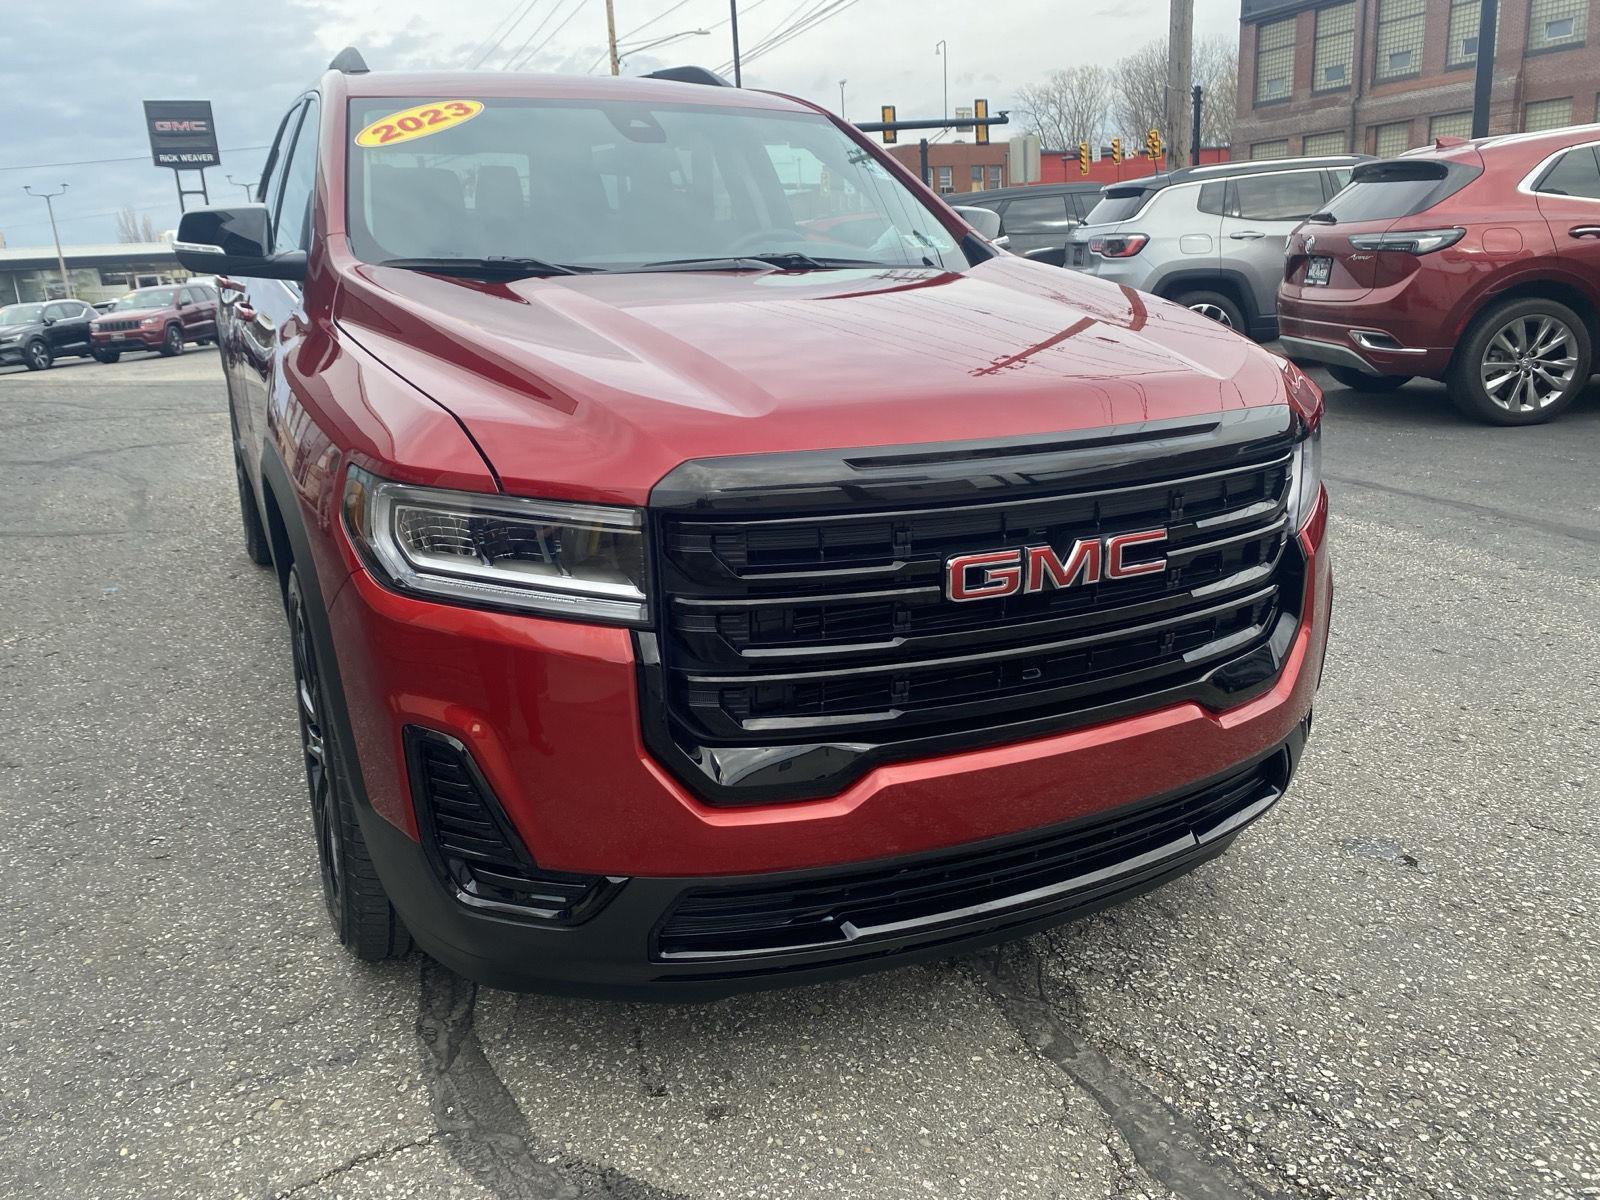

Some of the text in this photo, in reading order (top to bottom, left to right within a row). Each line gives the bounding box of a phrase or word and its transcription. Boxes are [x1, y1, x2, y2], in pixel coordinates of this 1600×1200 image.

[155, 121, 207, 131] GMC
[371, 102, 474, 143] 2023
[159, 153, 213, 162] RICK WEAVER
[946, 528, 1168, 602] GMC
